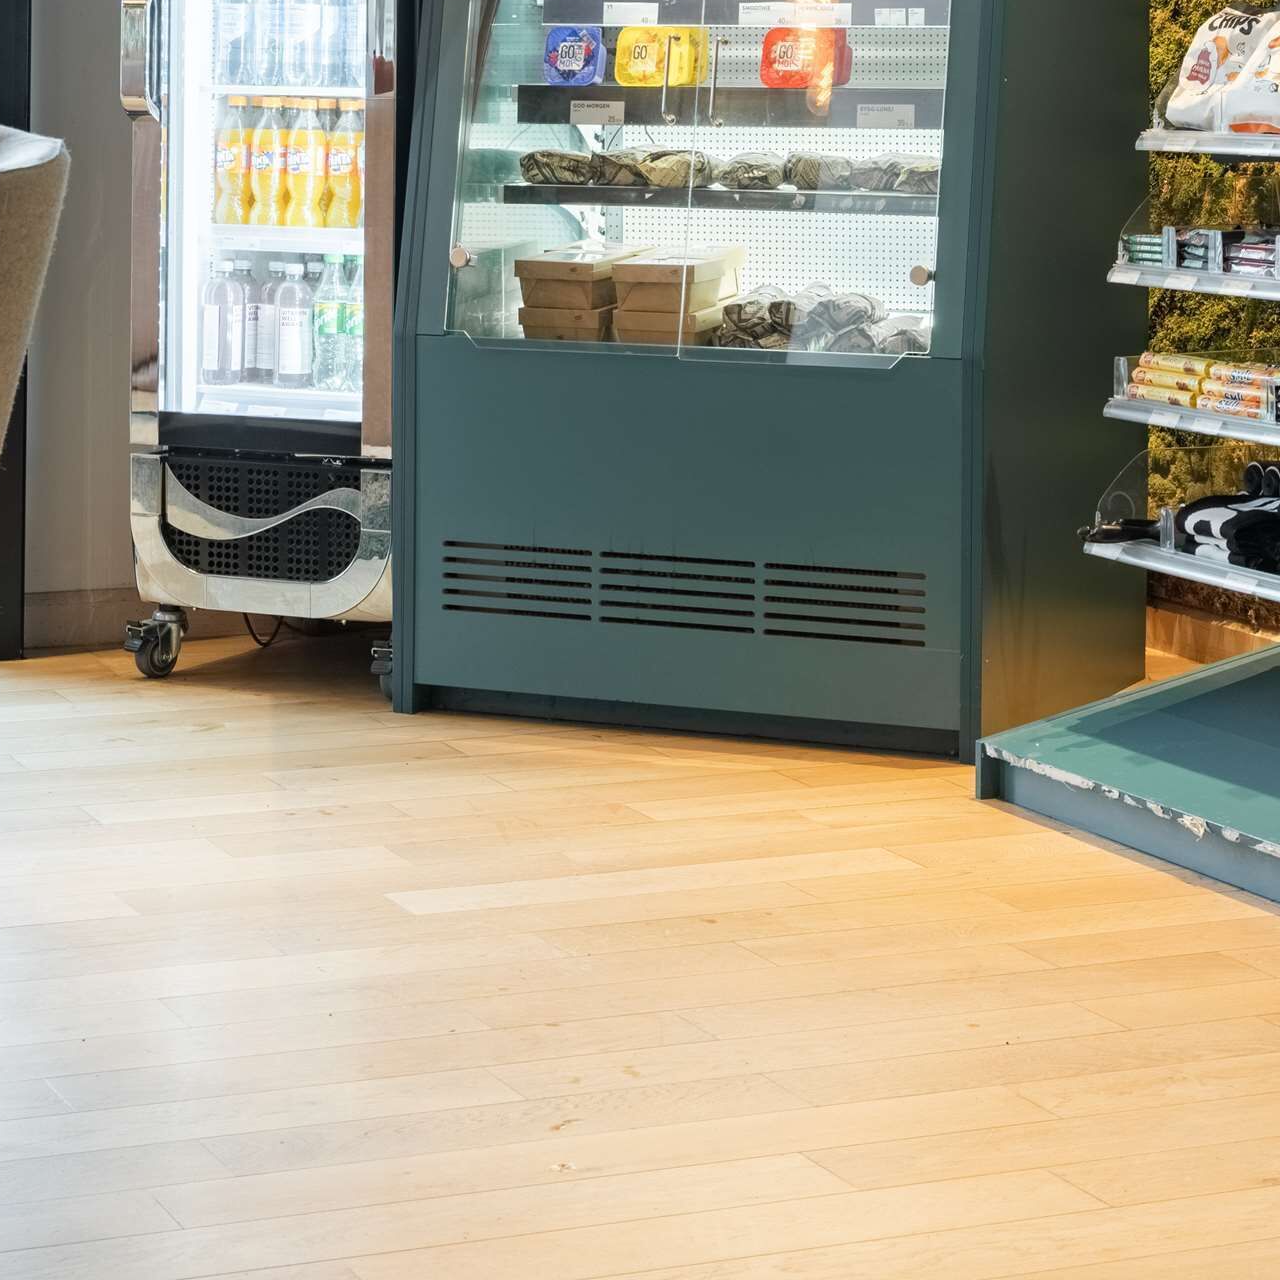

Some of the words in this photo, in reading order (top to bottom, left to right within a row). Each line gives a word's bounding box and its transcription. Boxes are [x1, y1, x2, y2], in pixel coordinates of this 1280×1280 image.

[1208, 14, 1261, 36] CHIPS
[560, 45, 575, 59] GO
[632, 45, 648, 60] GO
[778, 44, 794, 60] GO
